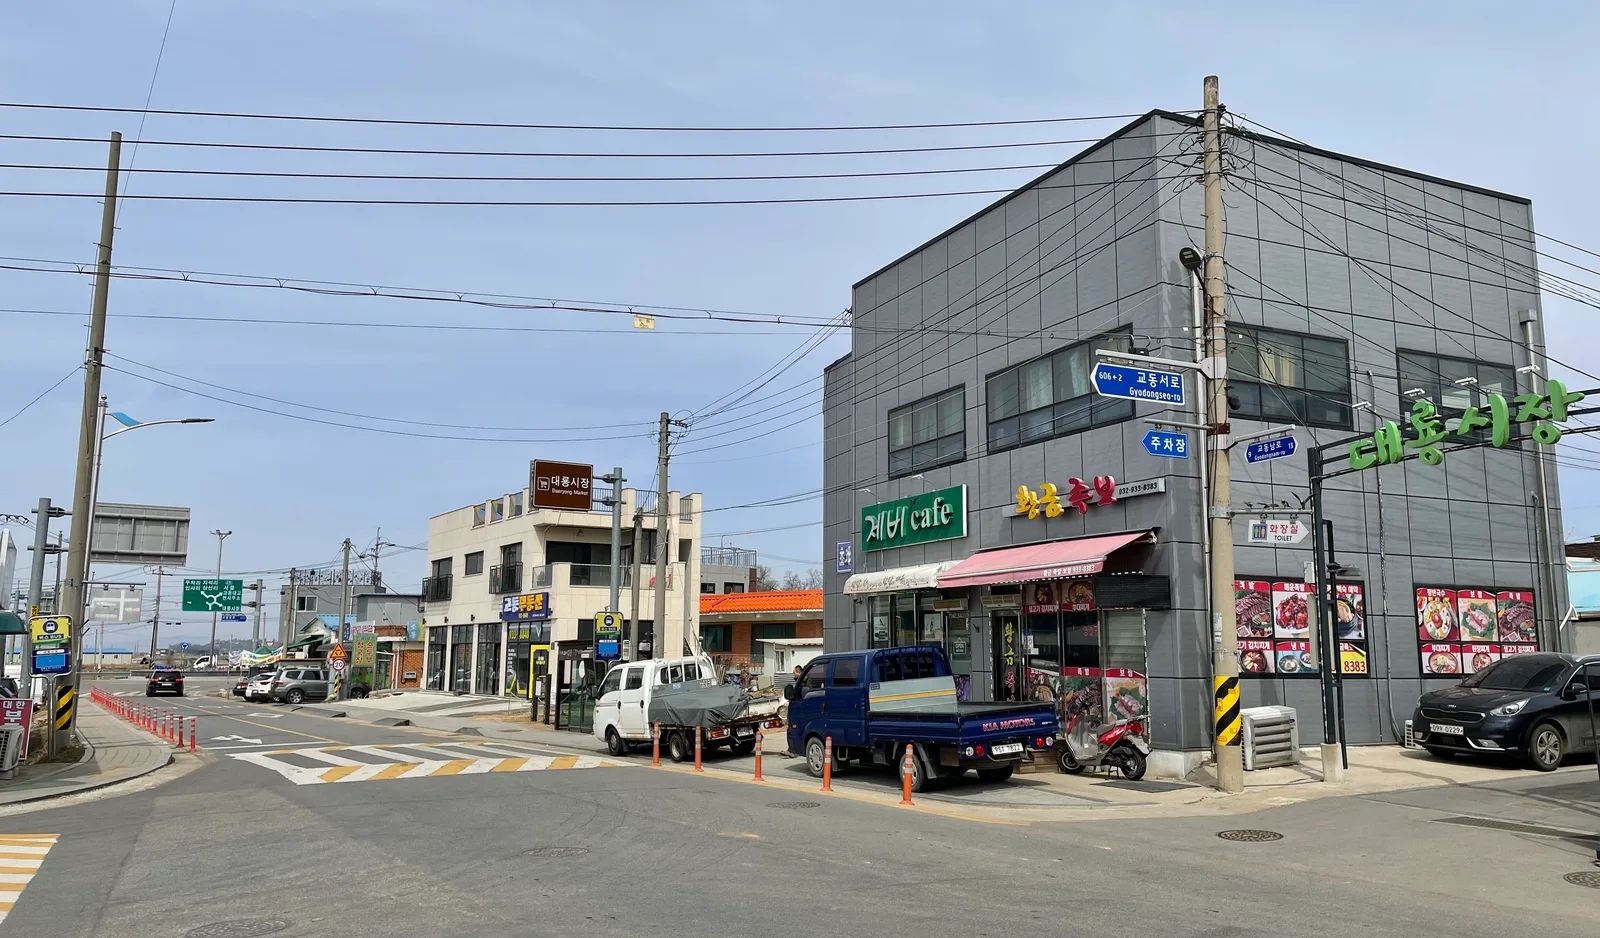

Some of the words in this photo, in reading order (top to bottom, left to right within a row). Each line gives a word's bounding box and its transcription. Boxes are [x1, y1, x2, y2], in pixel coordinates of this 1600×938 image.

[1099, 372, 1112, 380] 606
[1118, 374, 1123, 382] 2
[1137, 372, 1180, 388] 교동서로
[1129, 387, 1181, 401] Gyodongseo-ro
[1349, 379, 1585, 469] 대룡시장
[1151, 436, 1185, 452] 주차장
[1257, 441, 1282, 452] 교동남로
[1254, 450, 1286, 461] Gyodongnam-ro
[551, 475, 590, 489] 대룡시장
[1118, 482, 1158, 495] 032-933-8383
[551, 488, 573, 496] Daeryong
[864, 505, 909, 542] 제비
[910, 496, 954, 531] cafe
[1269, 524, 1298, 534] 화장실
[1344, 660, 1366, 672] 8383
[3, 700, 25, 709] 대한
[982, 722, 999, 732] KIA
[1000, 718, 1036, 730] MOTORS
